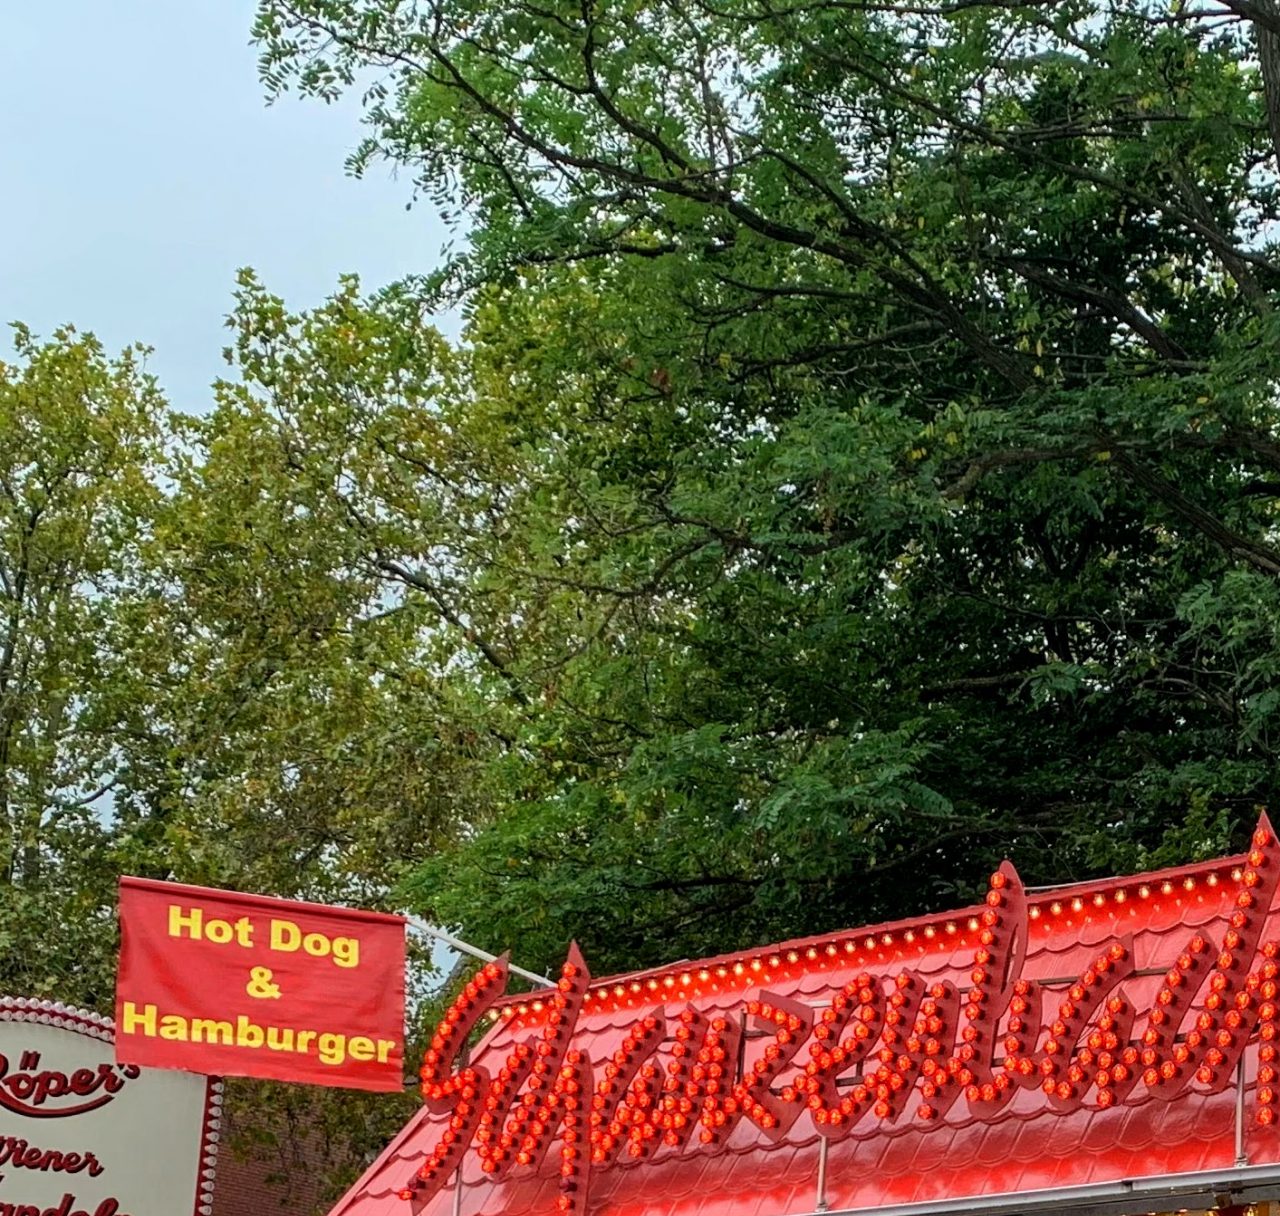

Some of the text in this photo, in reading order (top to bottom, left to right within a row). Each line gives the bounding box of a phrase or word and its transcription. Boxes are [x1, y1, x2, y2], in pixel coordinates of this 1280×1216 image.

[168, 904, 360, 968] Hot Dog
[246, 966, 282, 999] &
[122, 1001, 396, 1066] Hamburger
